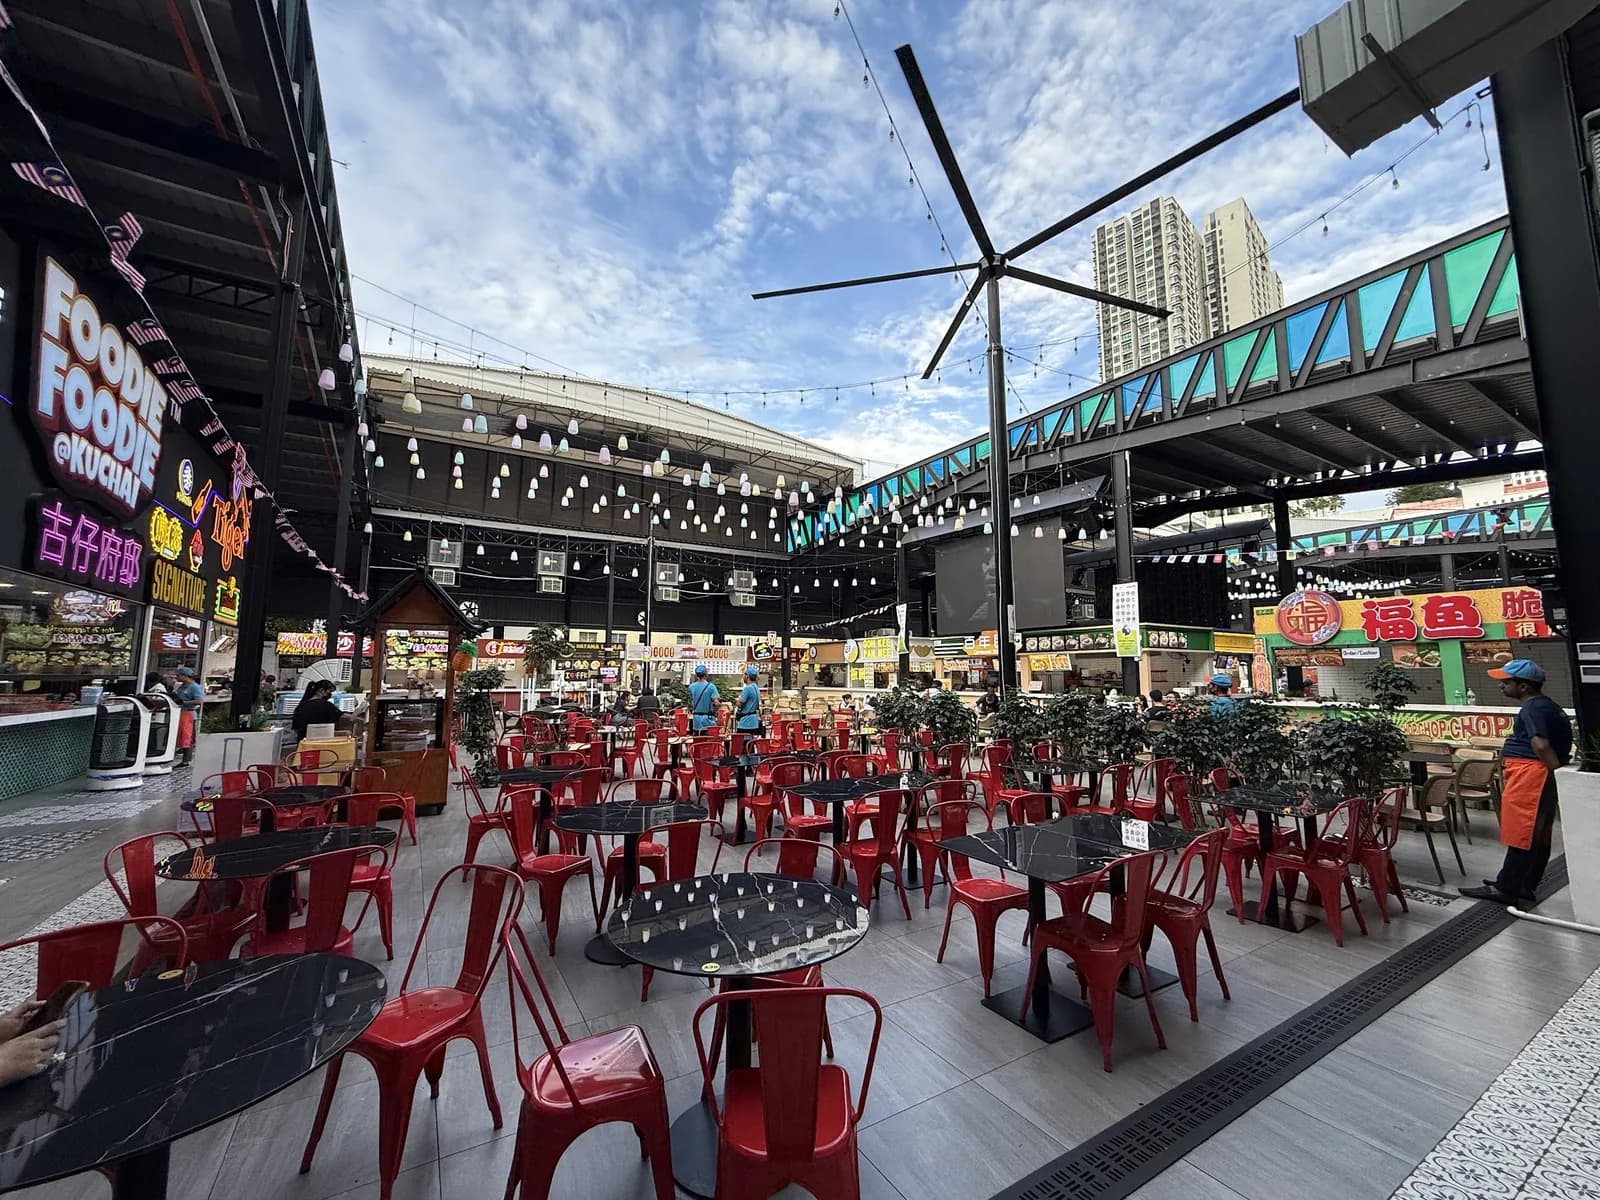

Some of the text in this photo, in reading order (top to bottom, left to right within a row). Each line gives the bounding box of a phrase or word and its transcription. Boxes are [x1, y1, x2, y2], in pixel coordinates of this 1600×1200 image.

[44, 256, 168, 437] FOODIE
[37, 334, 162, 487] FOODIE
[53, 433, 141, 510] @KUCHAI
[211, 493, 248, 572] Tiger
[151, 558, 207, 614] SIGNATURE
[1449, 714, 1513, 741] CHOP
